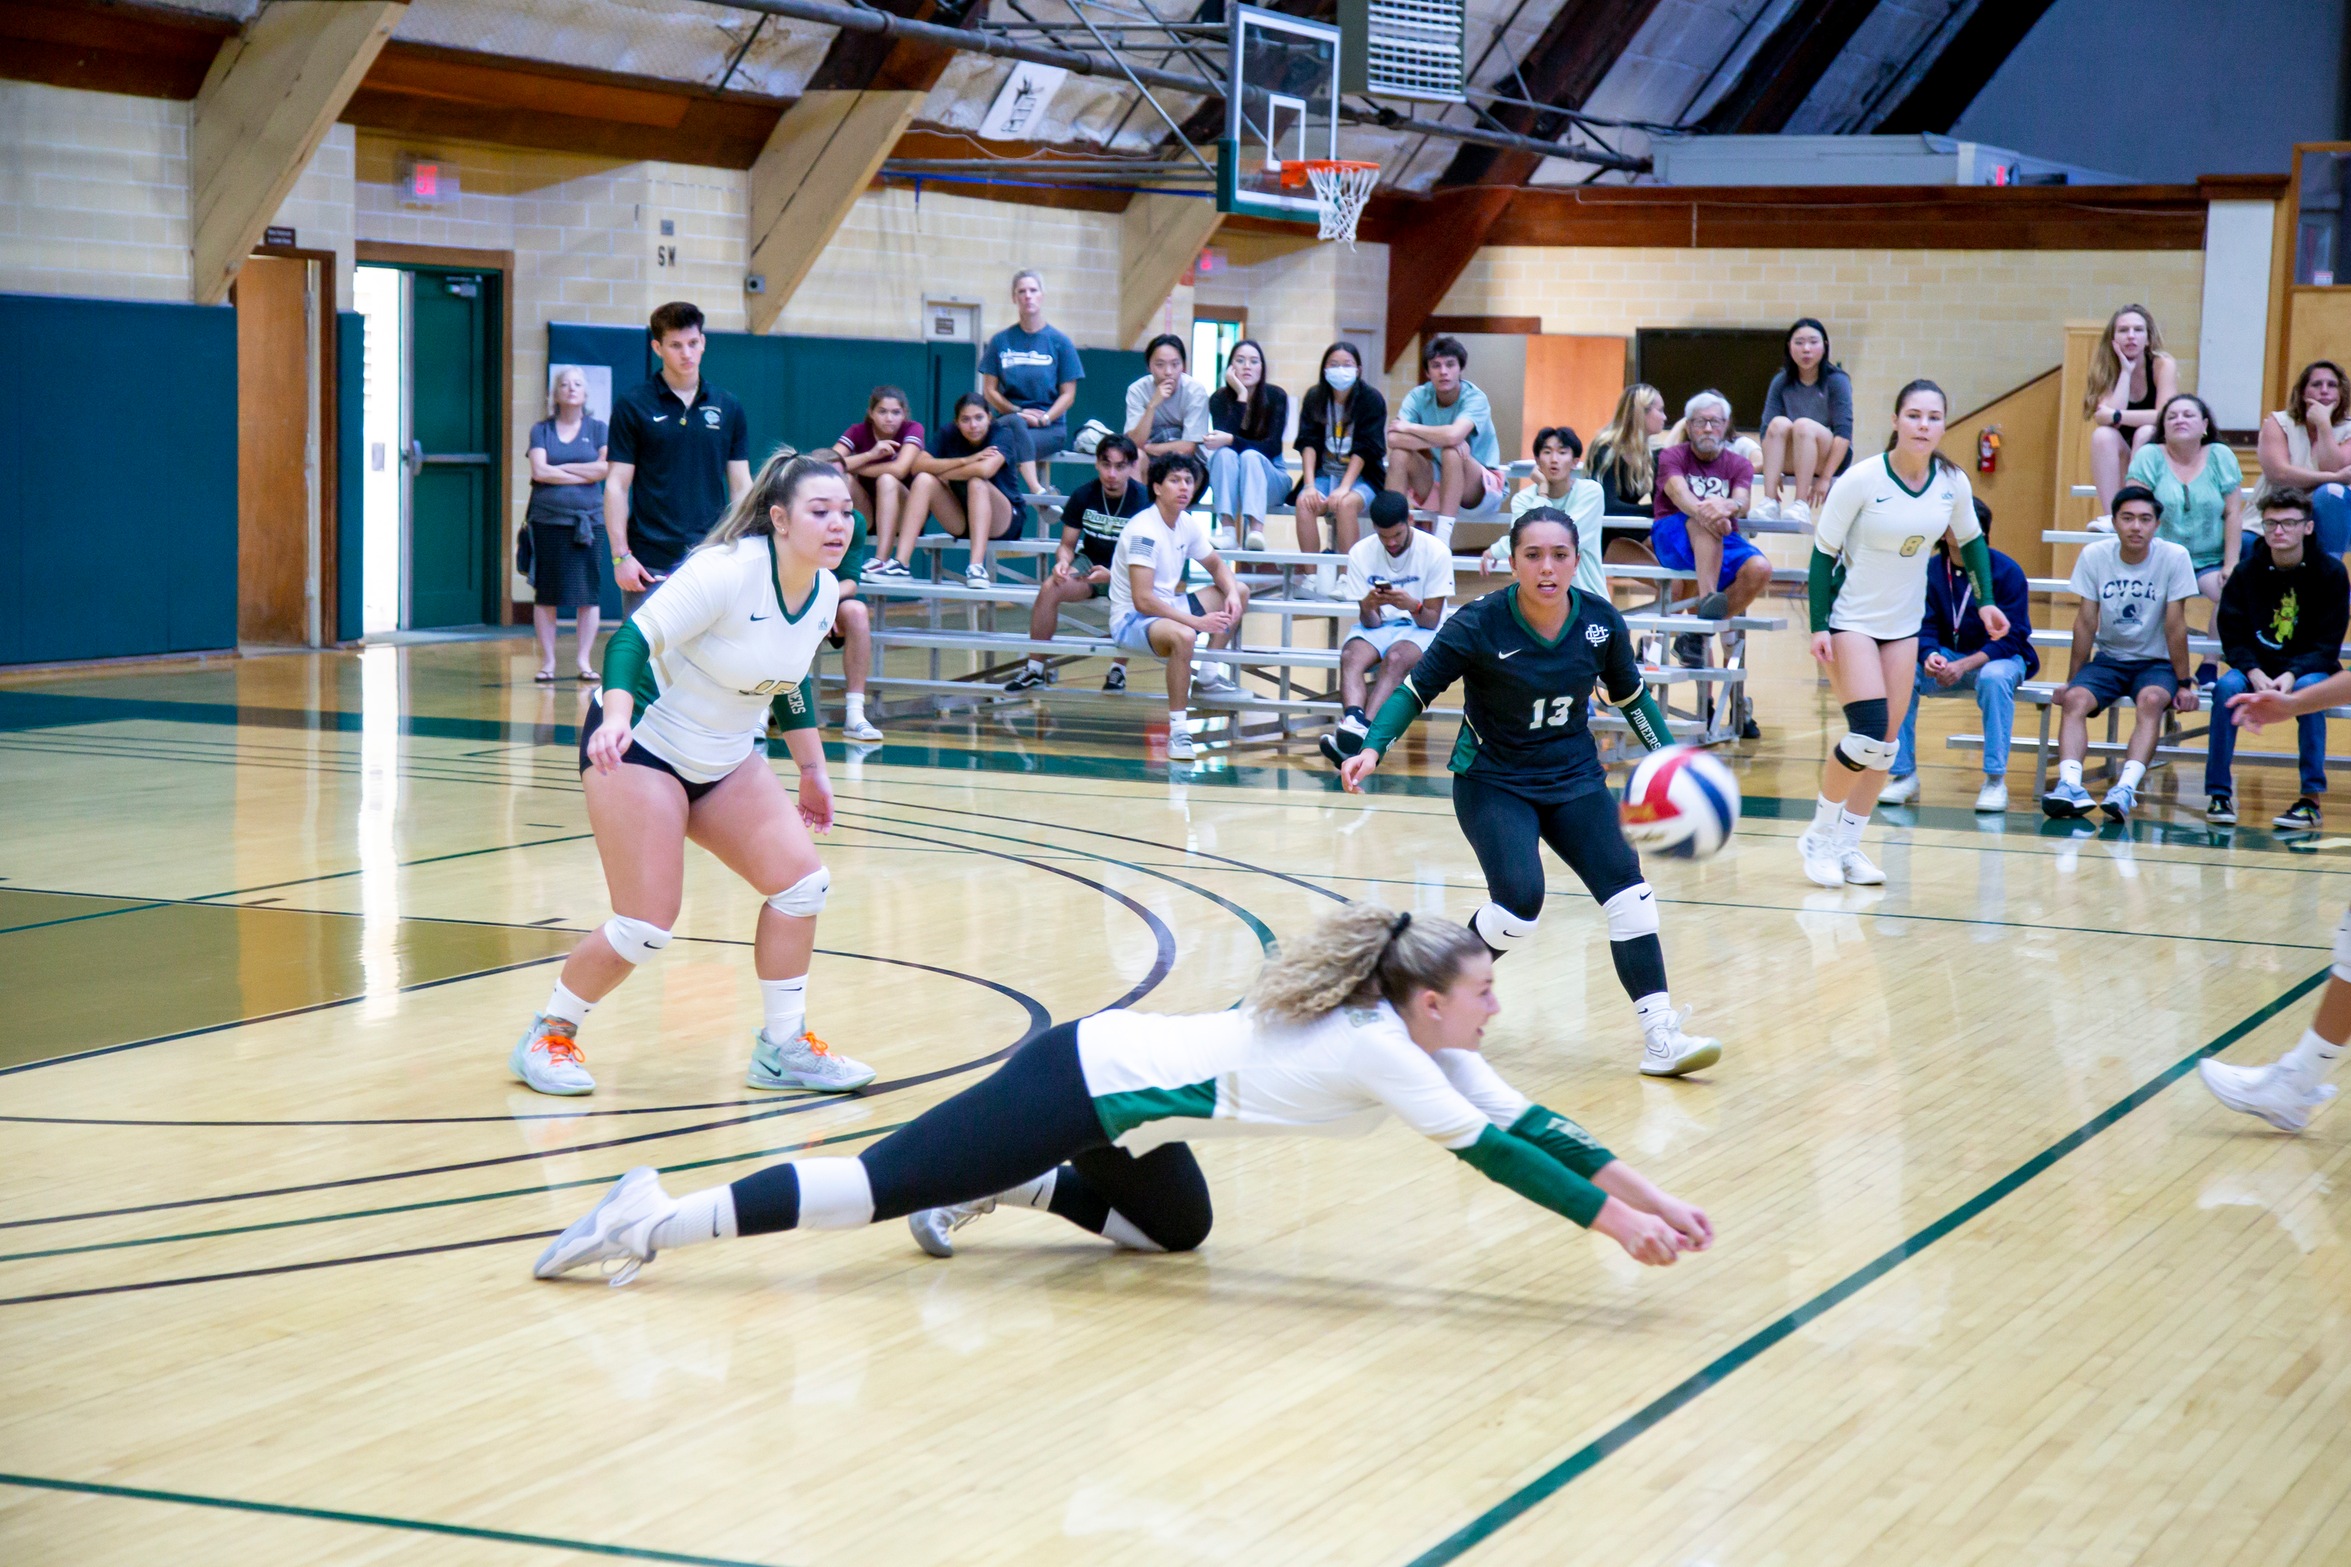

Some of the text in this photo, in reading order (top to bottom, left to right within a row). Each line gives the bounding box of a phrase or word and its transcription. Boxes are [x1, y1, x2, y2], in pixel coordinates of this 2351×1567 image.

[1899, 535, 1925, 557] 8
[1529, 696, 1574, 729] 13
[1630, 707, 1662, 751] PIONEERS
